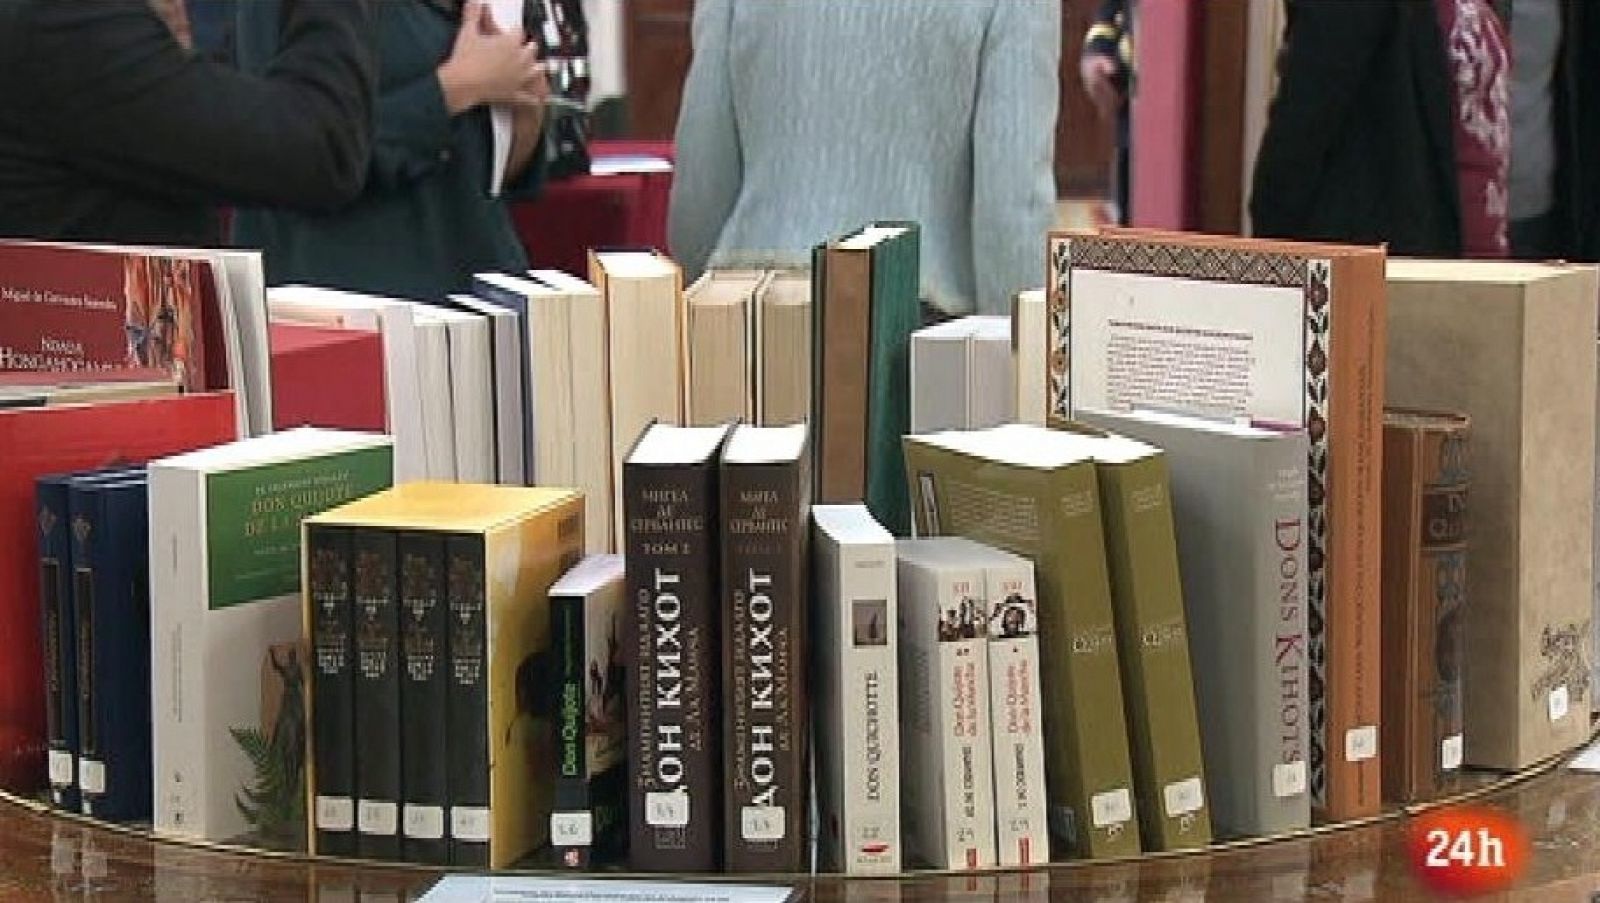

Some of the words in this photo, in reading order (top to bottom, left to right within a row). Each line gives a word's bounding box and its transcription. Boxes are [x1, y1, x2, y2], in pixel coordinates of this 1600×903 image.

[655, 567, 682, 709] КИХОТ
[749, 567, 774, 709] КИХОТ
[562, 682, 580, 742] Quijote
[864, 671, 881, 766] QUICHOTTE
[562, 745, 578, 775] Don
[867, 767, 881, 801] DON
